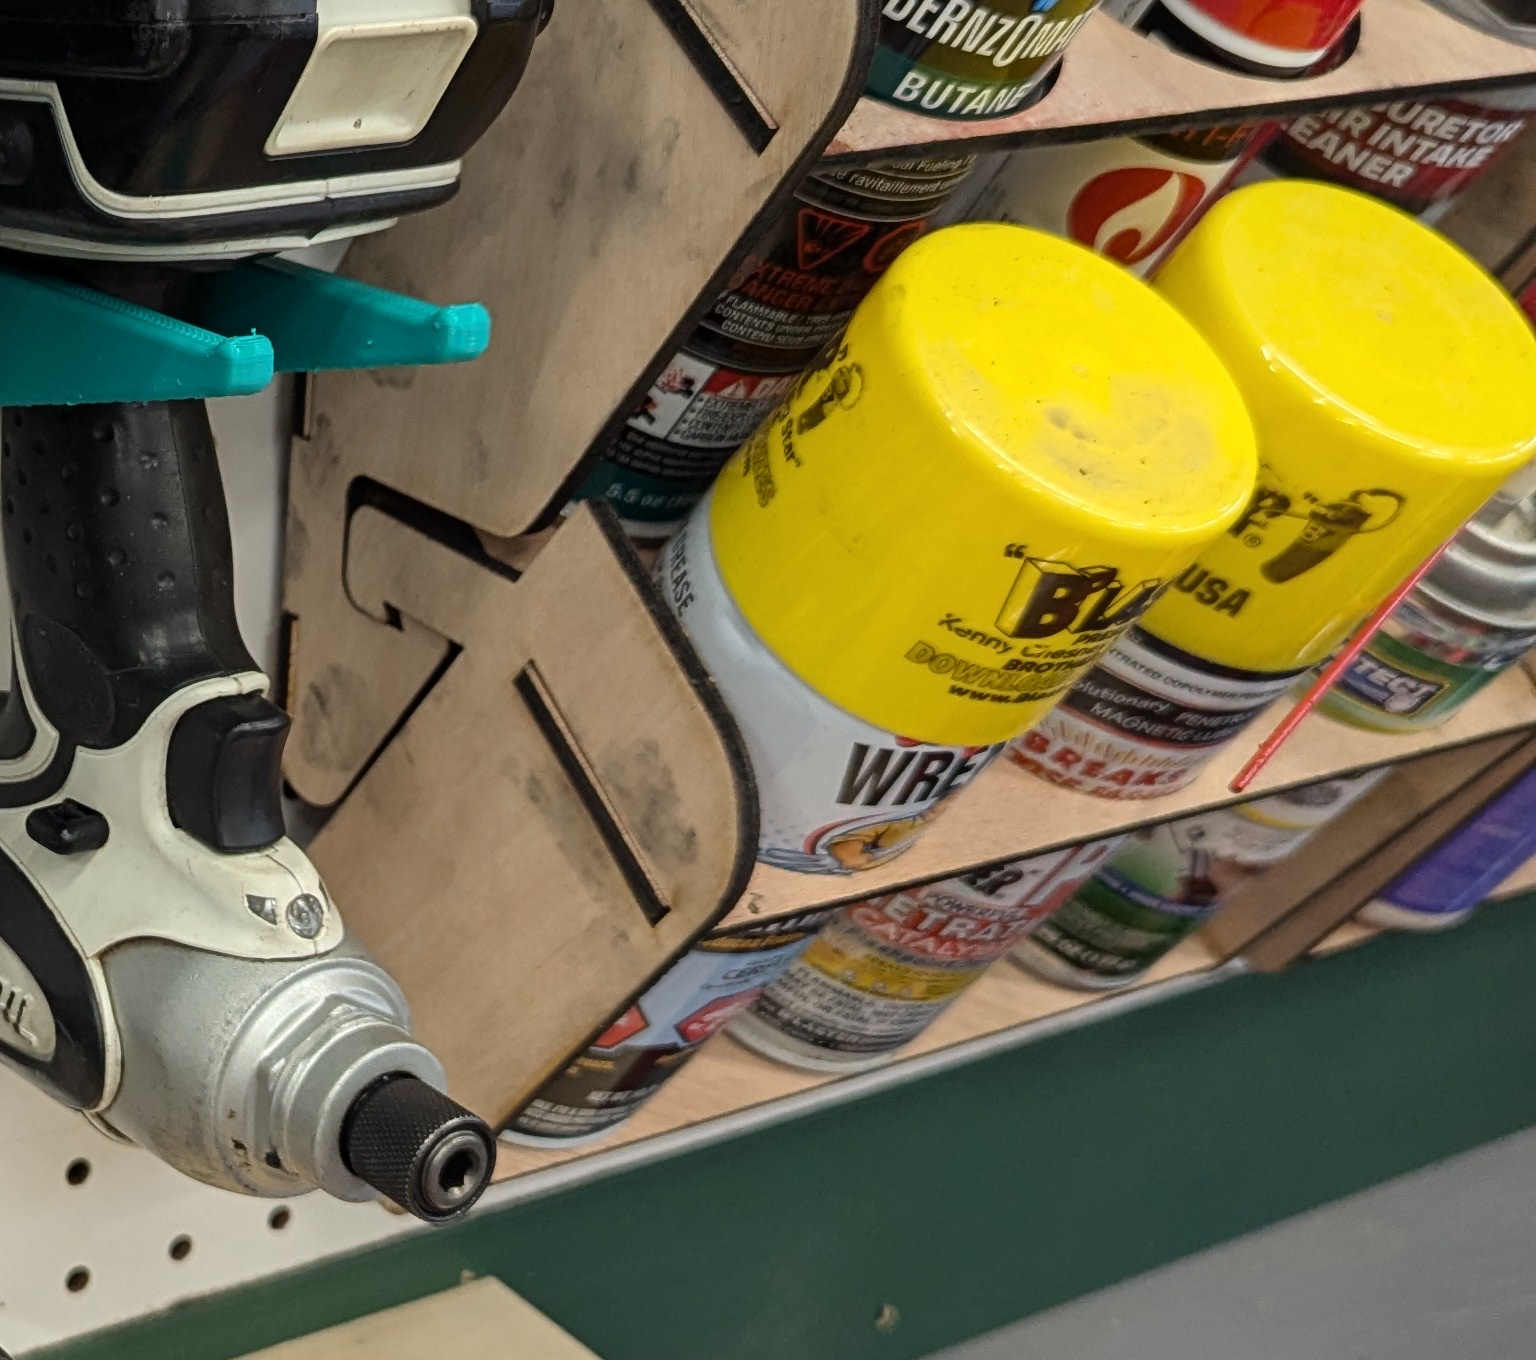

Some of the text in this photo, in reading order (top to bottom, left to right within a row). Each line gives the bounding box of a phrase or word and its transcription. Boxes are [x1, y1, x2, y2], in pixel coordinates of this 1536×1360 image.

[891, 70, 1033, 115] BUTANE
[1367, 123, 1496, 169] INTAKE
[848, 169, 944, 195] ravitaillement
[715, 304, 773, 331] CONTENTS
[1173, 562, 1251, 618] USA
[938, 613, 1012, 654] Kenny
[1090, 702, 1194, 741] MAGNETIC
